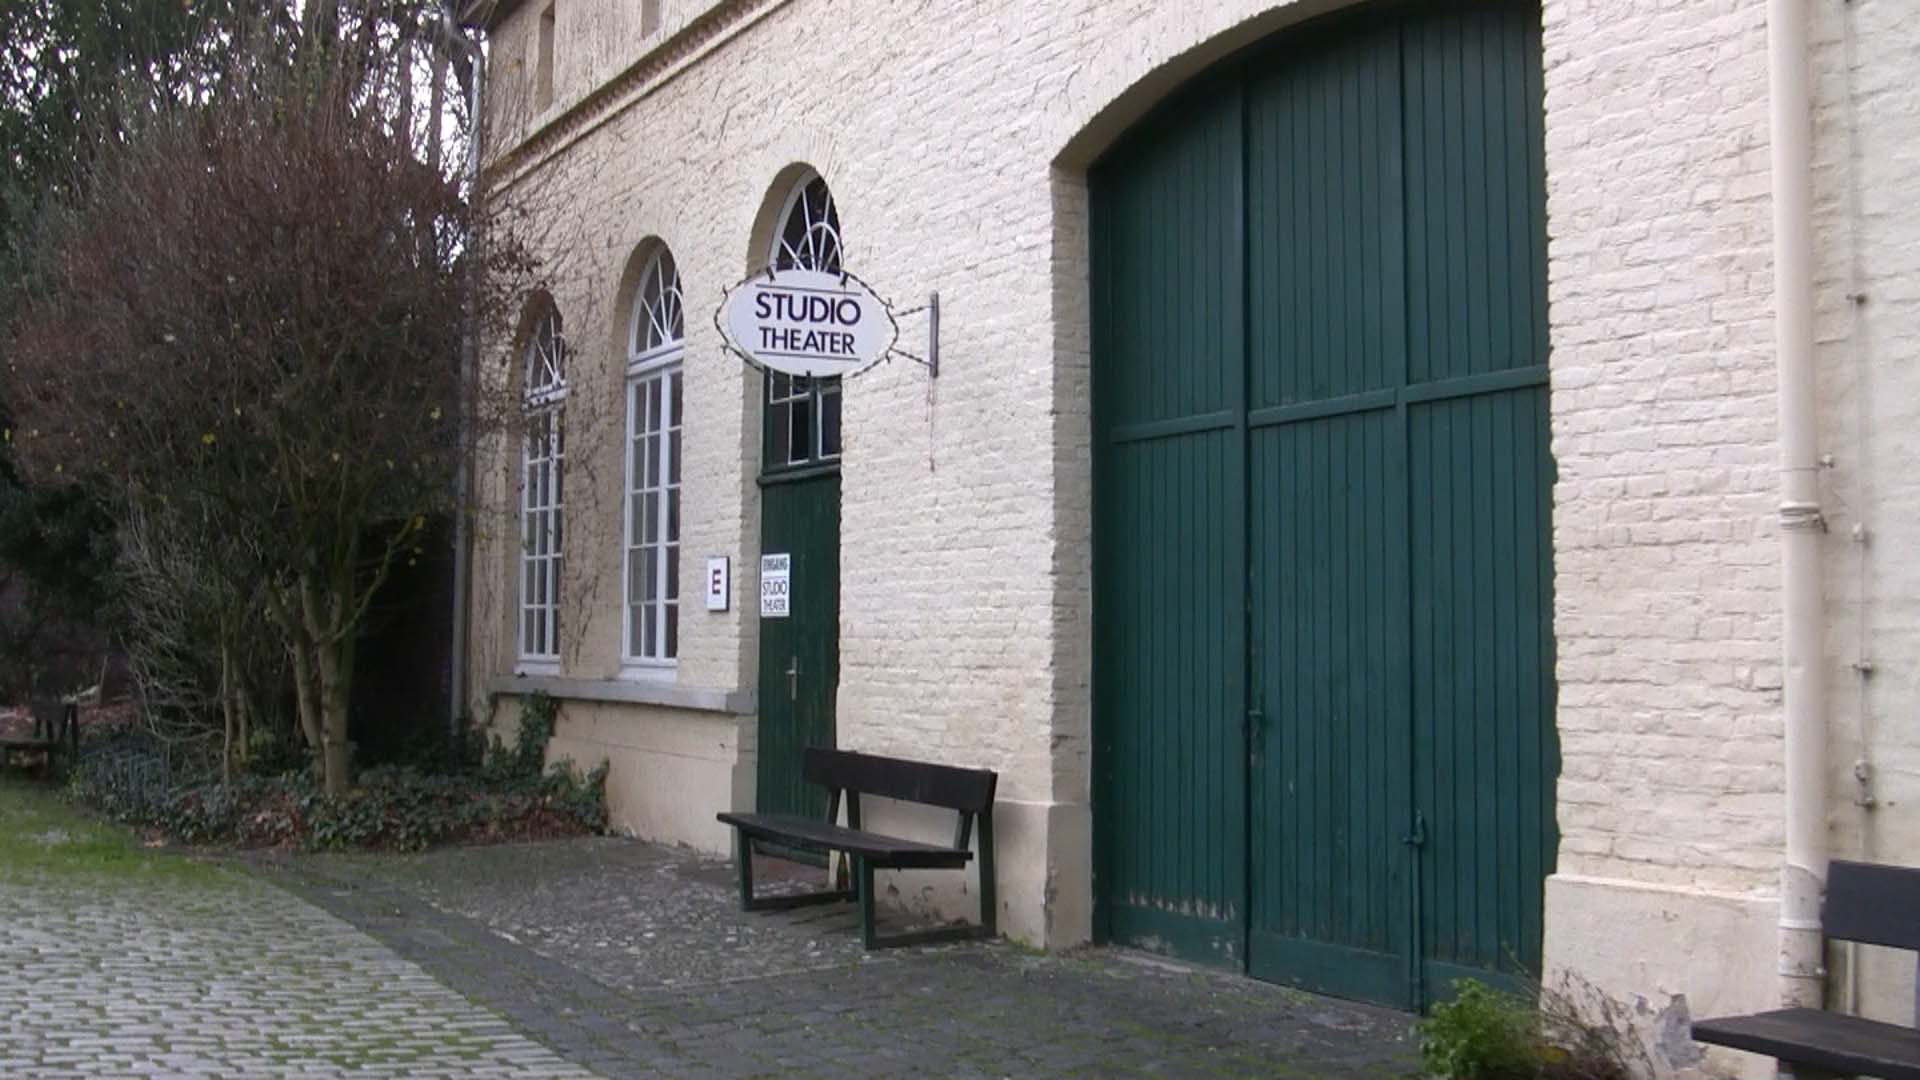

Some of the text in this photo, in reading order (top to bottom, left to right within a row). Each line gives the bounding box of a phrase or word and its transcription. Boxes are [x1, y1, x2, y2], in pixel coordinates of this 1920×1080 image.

[755, 291, 861, 326] STUDIO
[759, 326, 855, 354] THEATER
[712, 569, 721, 594] E
[763, 580, 787, 596] STUDIO
